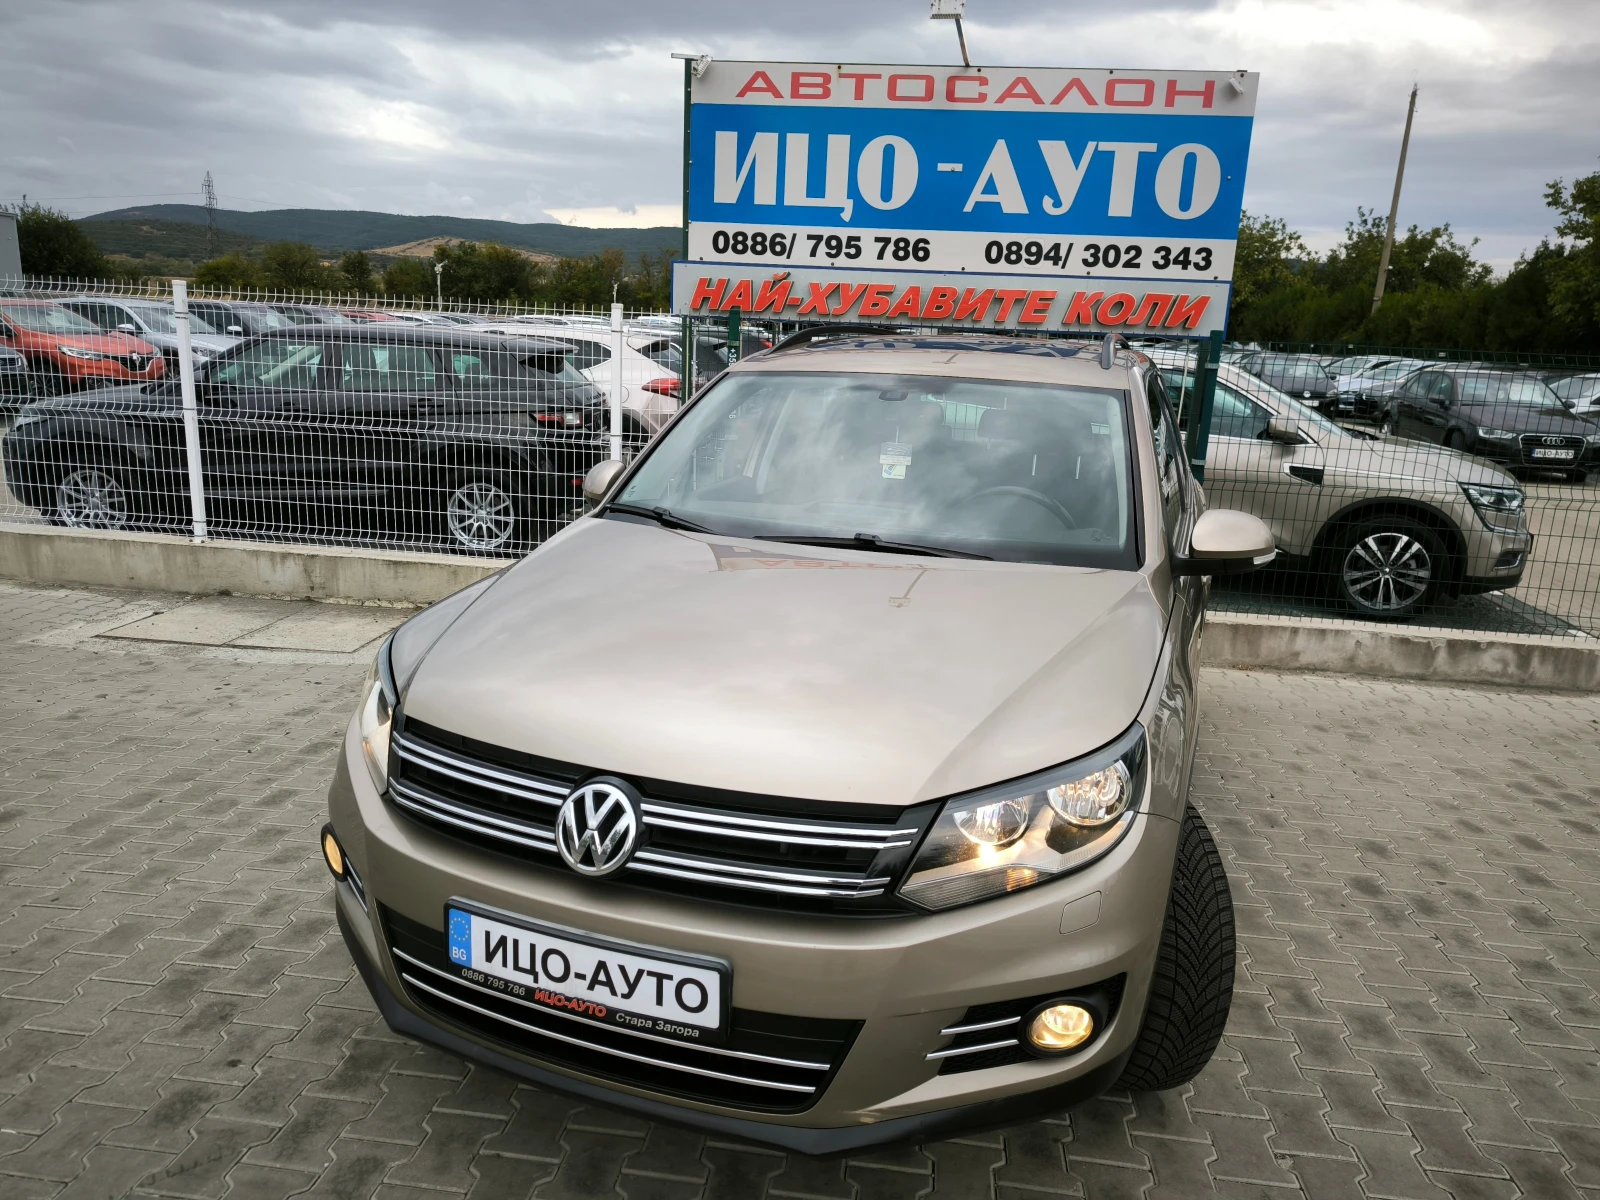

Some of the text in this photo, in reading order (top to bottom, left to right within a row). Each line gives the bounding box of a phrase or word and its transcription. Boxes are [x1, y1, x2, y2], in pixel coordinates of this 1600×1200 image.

[736, 70, 1216, 109] АВТОСАЛОН
[712, 231, 931, 263] 0886/ 795 786
[983, 240, 1213, 272] 0894/ 302 343
[689, 271, 1211, 330] НАЙ-ХУБАВИТЕ КОЛИ
[452, 946, 467, 961] BG
[461, 968, 526, 997] 0886 795 786
[484, 930, 709, 1014] ИЦО-АУТО
[534, 988, 700, 1038] ИЦО-АУТО Стара Загора
